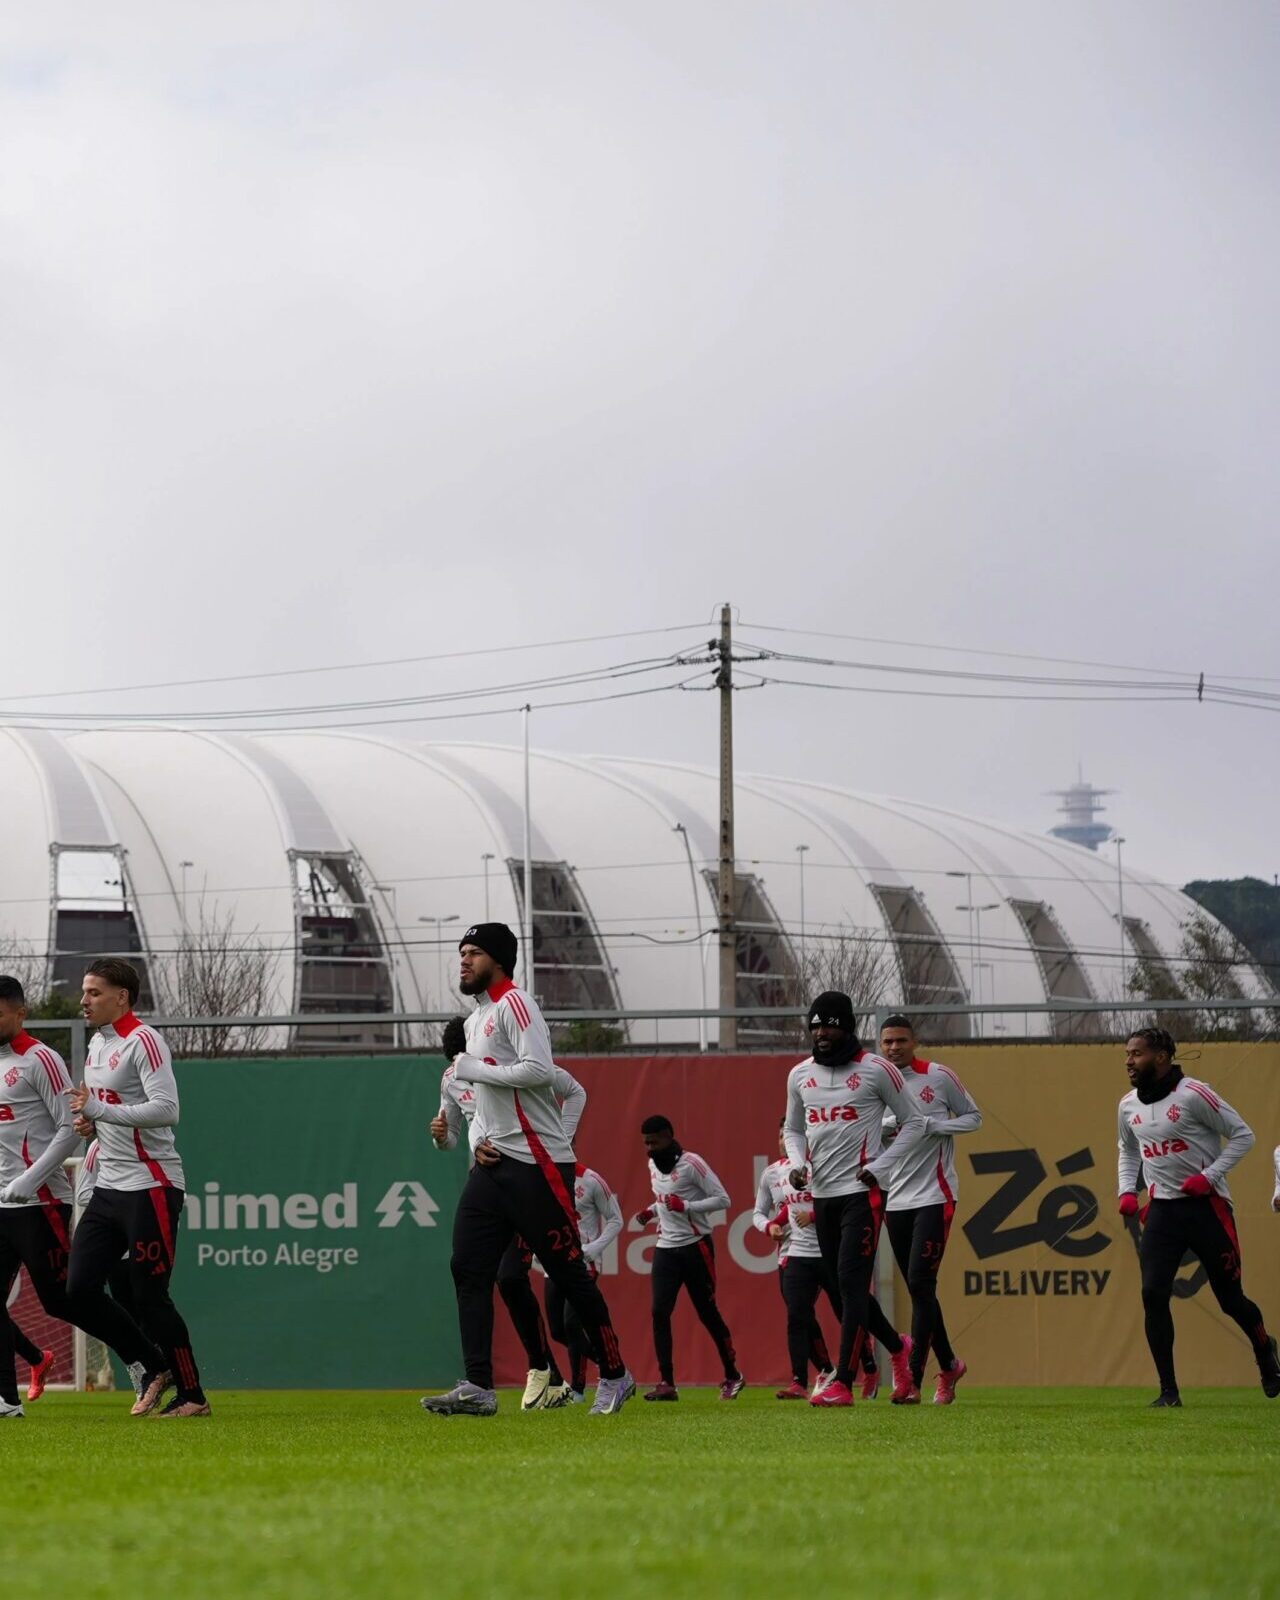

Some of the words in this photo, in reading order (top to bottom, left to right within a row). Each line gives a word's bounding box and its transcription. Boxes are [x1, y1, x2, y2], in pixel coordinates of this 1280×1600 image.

[962, 1147, 1112, 1260] Zé
[135, 1240, 161, 1263] 50
[198, 1244, 268, 1267] Porto
[274, 1242, 359, 1273] Alegre
[964, 1269, 1112, 1296] DELIVERY
